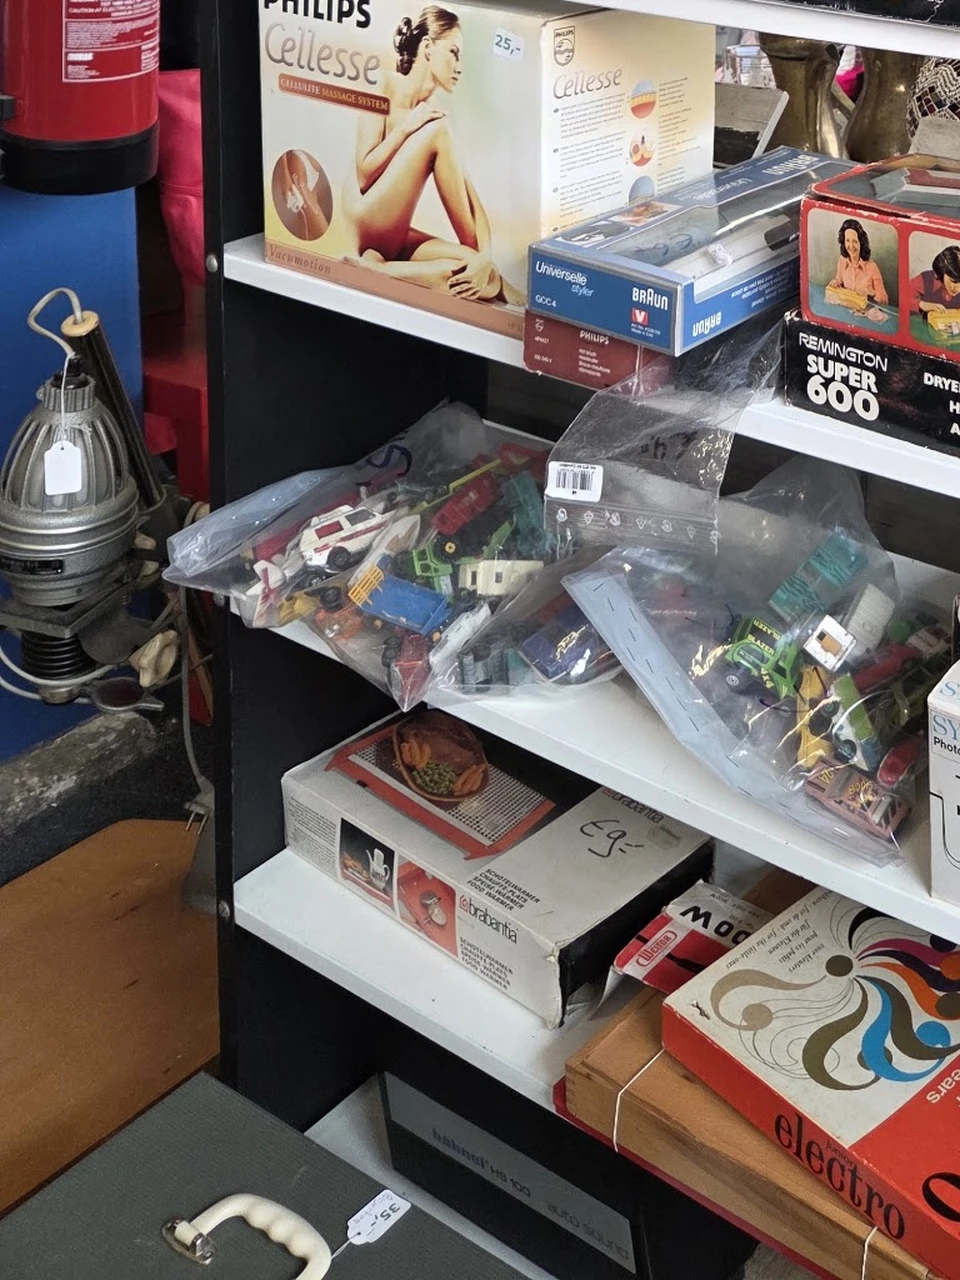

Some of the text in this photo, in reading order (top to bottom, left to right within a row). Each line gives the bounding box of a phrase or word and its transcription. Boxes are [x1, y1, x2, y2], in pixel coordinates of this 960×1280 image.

[494, 33, 521, 55] 25,-
[554, 28, 575, 38] PHILIPS
[264, 22, 381, 86] Cellesse
[280, 78, 389, 111] CELLULITE MASSAGE SYSTEM
[553, 68, 623, 100] Cellesse
[269, 243, 331, 275] Vacumotion
[535, 260, 588, 286] Universelle
[570, 284, 595, 298] styler
[632, 286, 669, 311] BRAUN
[579, 329, 610, 346] PHILIPS
[692, 311, 722, 337] BRAUN
[798, 331, 888, 372] REMINGTON
[806, 353, 879, 395] SUPER
[806, 374, 880, 422] 600
[466, 879, 515, 911] FOOD WARMER
[484, 868, 541, 904] SCHOTELWARMER
[468, 897, 518, 945] brabantia
[509, 1176, 532, 1199] 100
[774, 1110, 906, 1241] electro
[369, 1202, 402, 1228] 35,-
